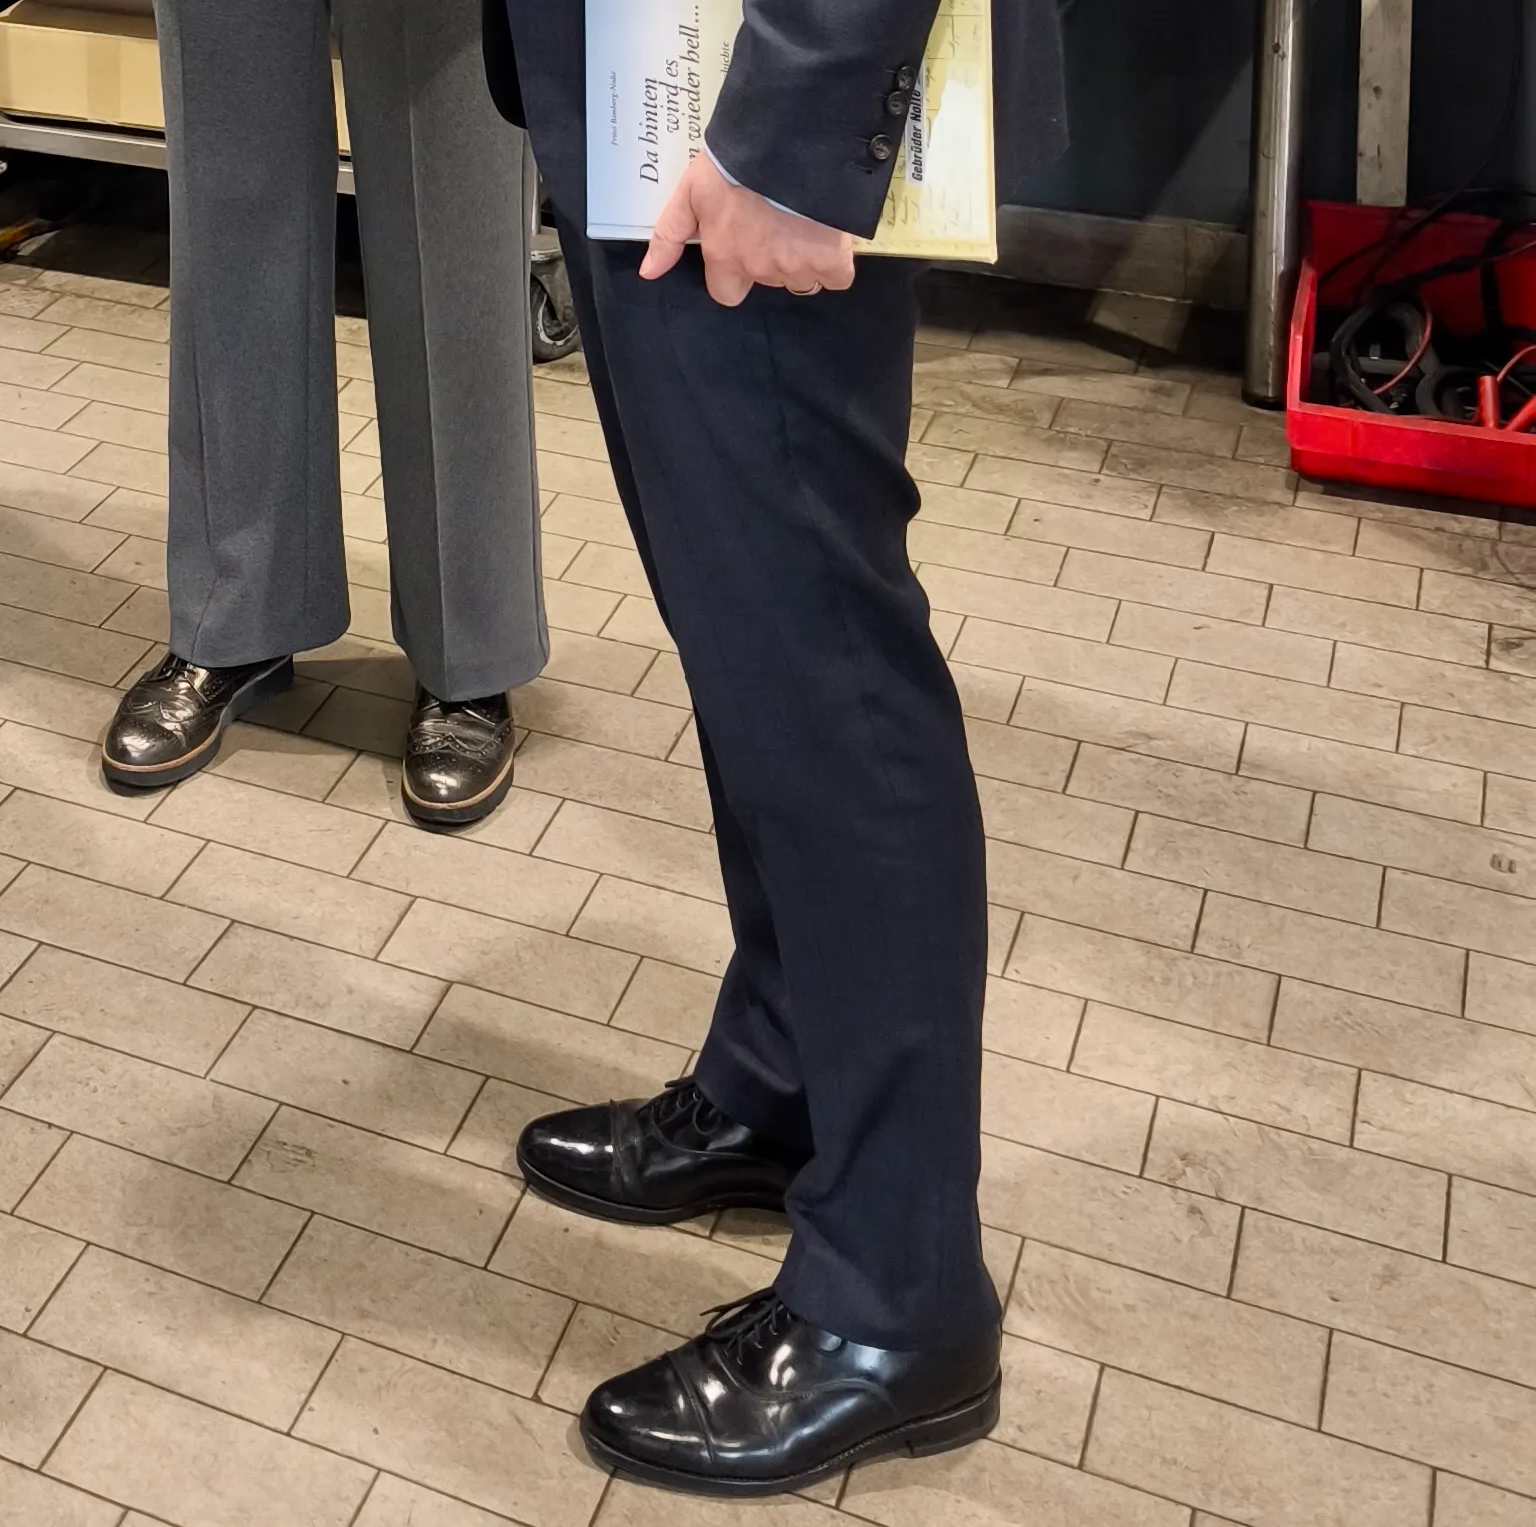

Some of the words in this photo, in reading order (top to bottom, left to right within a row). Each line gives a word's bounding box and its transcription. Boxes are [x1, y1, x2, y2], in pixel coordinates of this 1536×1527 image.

[665, 59, 679, 78] es
[637, 77, 659, 145] hinten
[658, 80, 679, 134] wird
[679, 67, 701, 141] wieder
[639, 150, 659, 184] Da
[910, 125, 923, 182] Gebrüder
